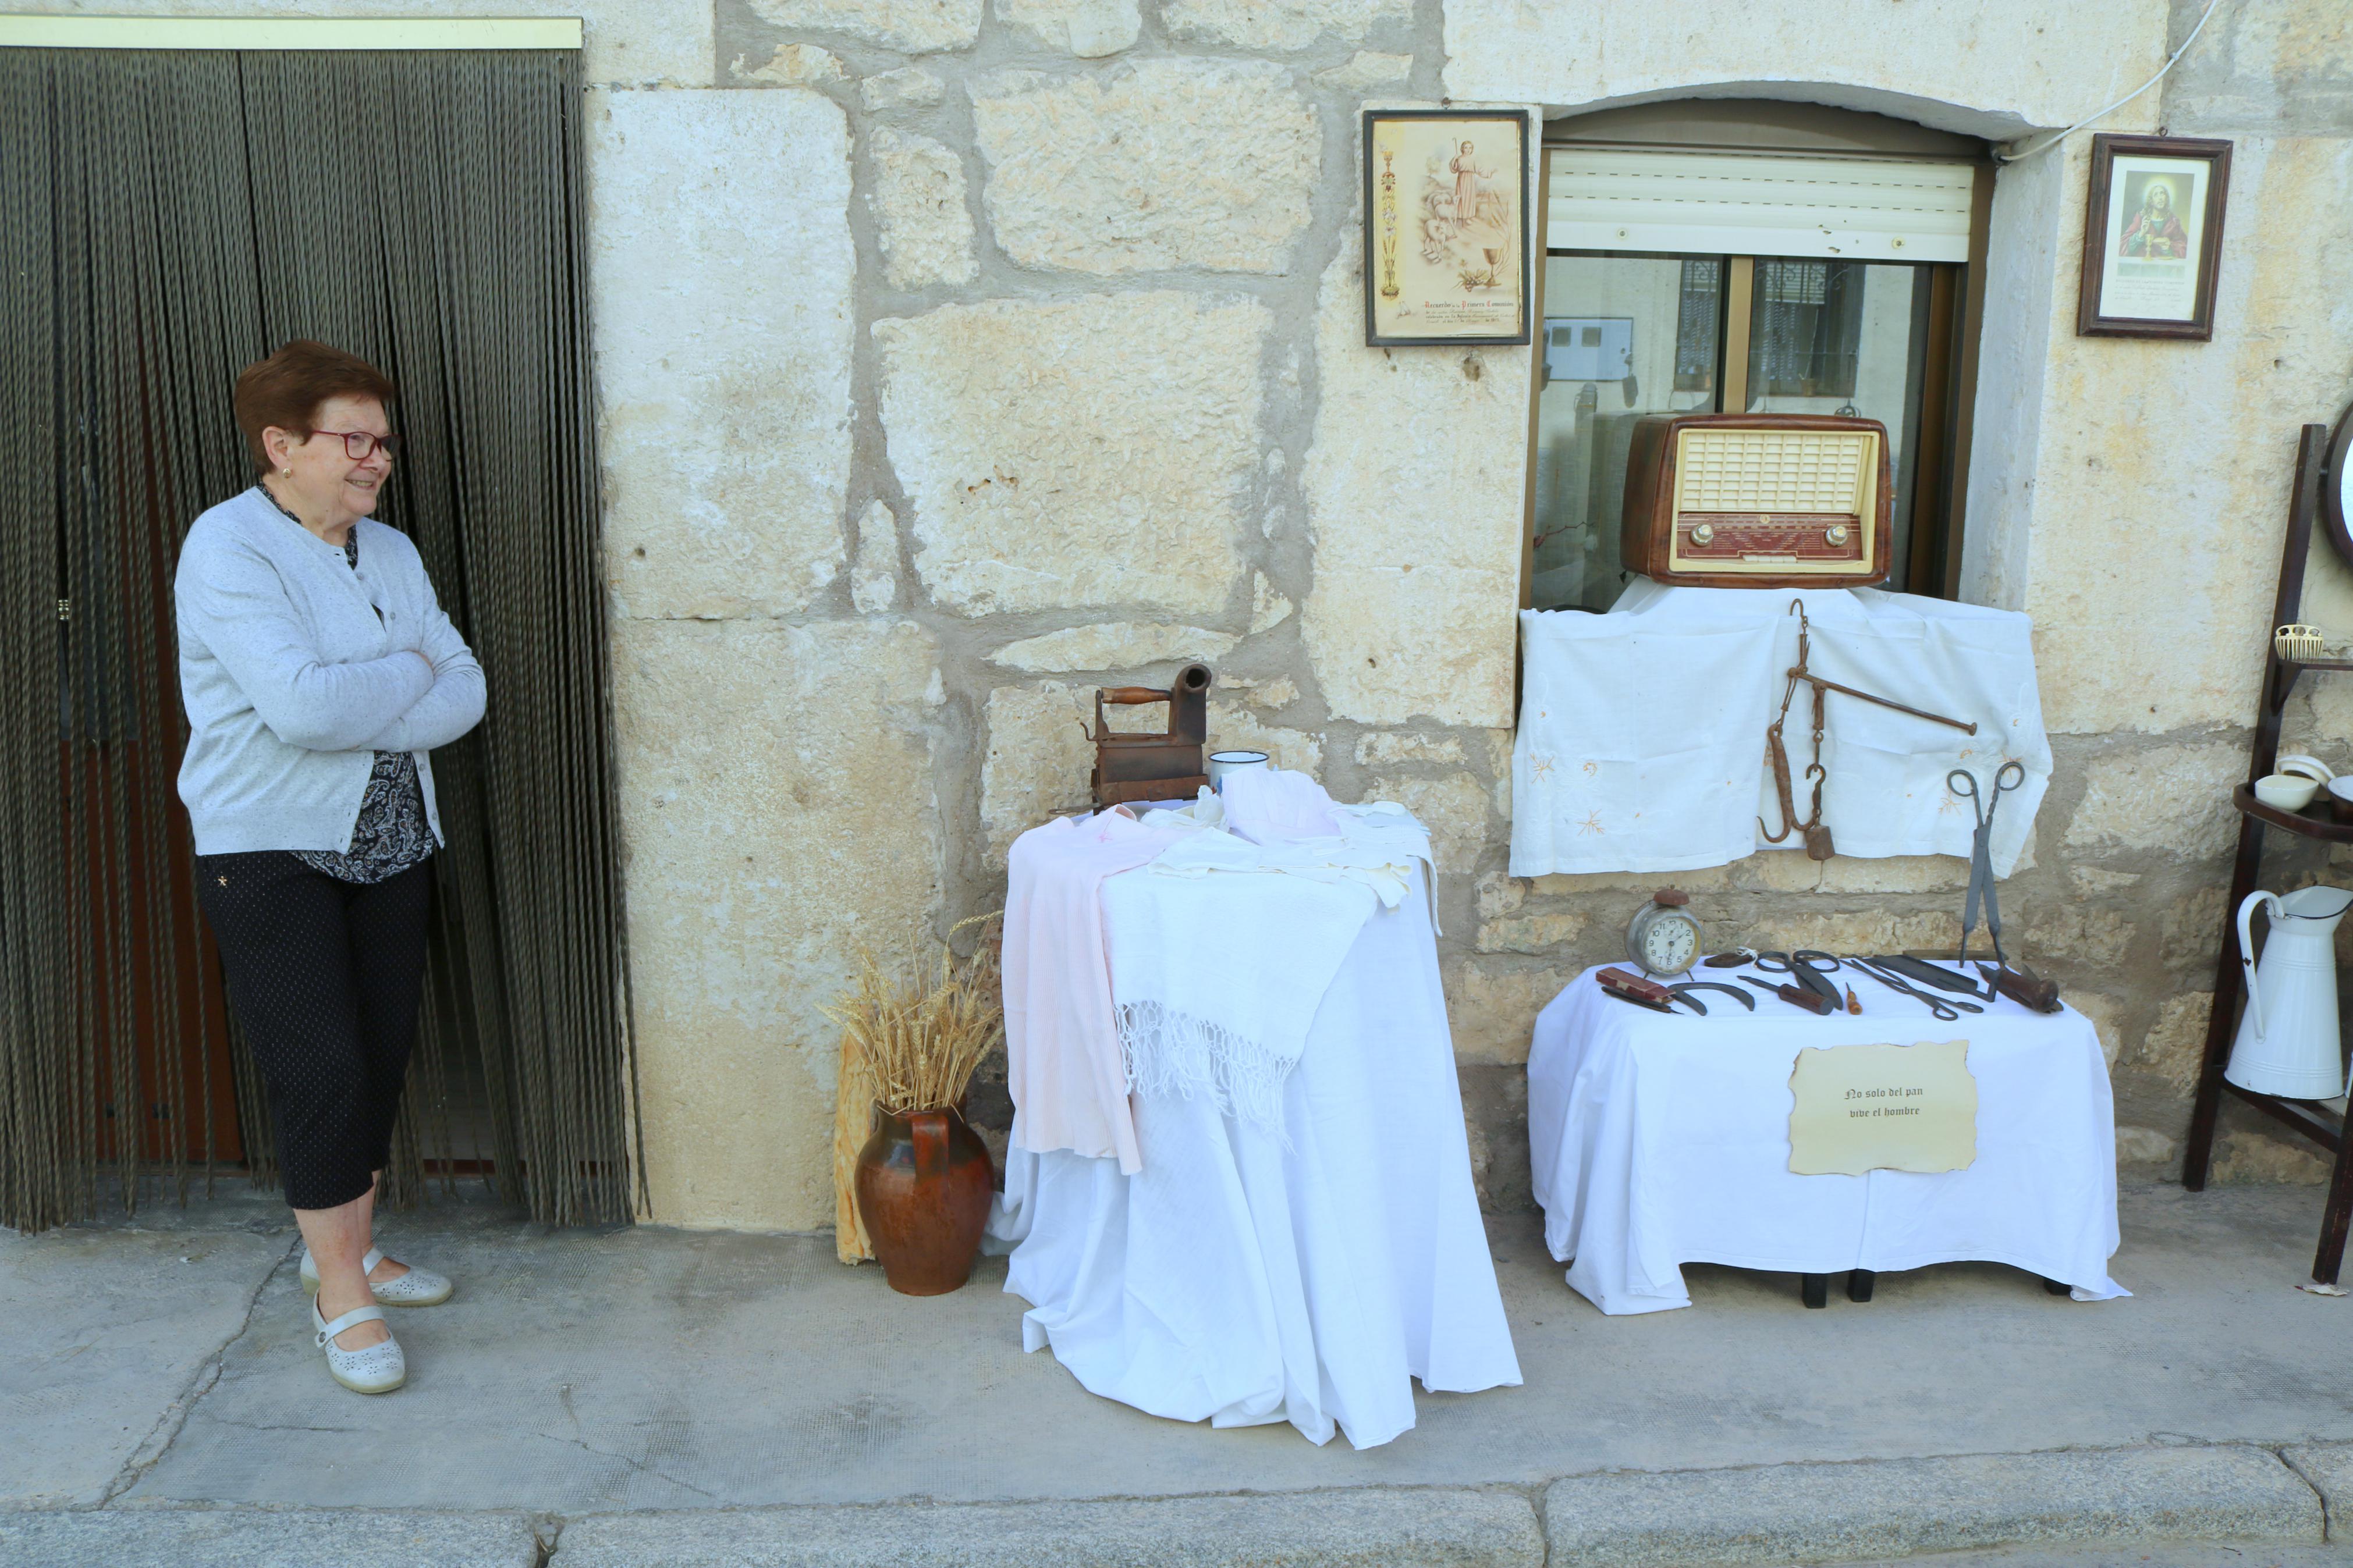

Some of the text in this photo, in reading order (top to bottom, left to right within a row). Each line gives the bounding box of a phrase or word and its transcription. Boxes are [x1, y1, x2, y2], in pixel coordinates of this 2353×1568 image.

[1461, 300, 1485, 310] Primera
[1658, 956, 1663, 965] 7
[1844, 1087, 1923, 1100] No solo del pan
[1850, 1106, 1920, 1118] vive el hombre
